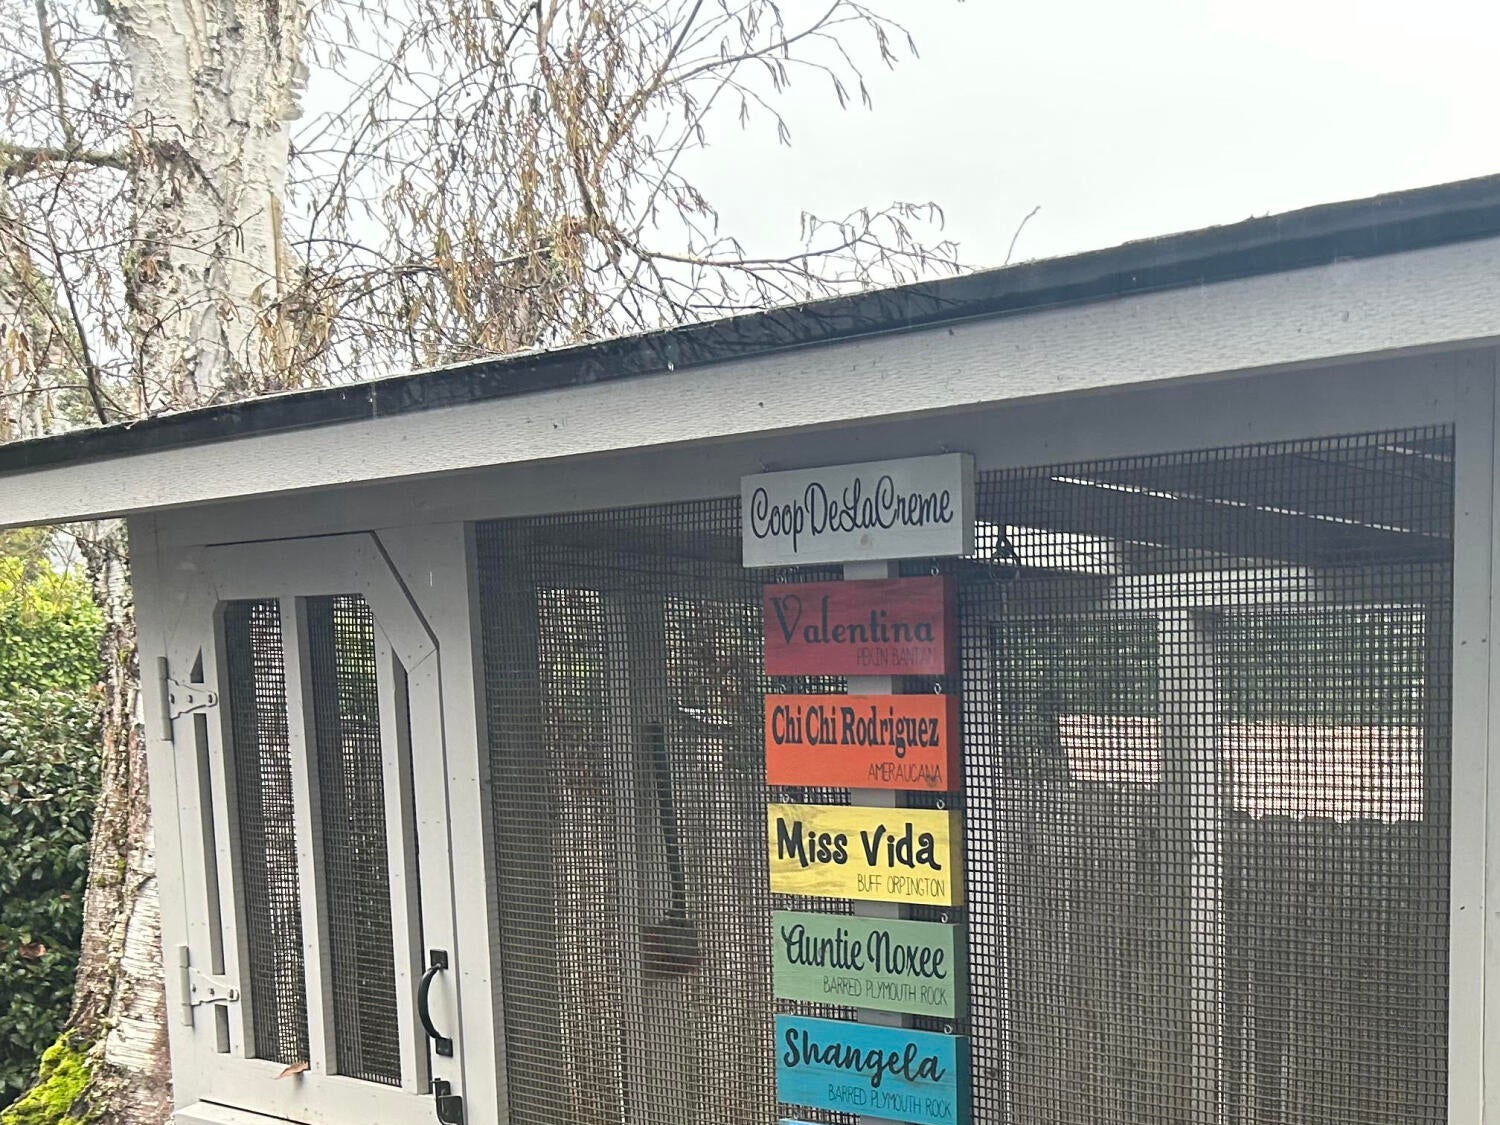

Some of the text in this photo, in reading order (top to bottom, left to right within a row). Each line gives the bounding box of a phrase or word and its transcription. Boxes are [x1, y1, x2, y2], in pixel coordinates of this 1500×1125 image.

[751, 475, 953, 553] CoopDeLaCreme
[770, 594, 935, 645] Valentina
[772, 705, 939, 758] Chi Chi Rodriguez
[868, 762, 942, 783] AMERAUCANA
[776, 818, 941, 871] Miss Vida
[858, 874, 945, 897] BUFF ORPINGTON
[781, 924, 947, 979] Auntie Noxee
[824, 976, 948, 1005] BARRED PLYMOUTH ROCK
[784, 1028, 945, 1088] Shangela
[828, 1084, 951, 1118] BARRED PLYMOUTH ROCK
